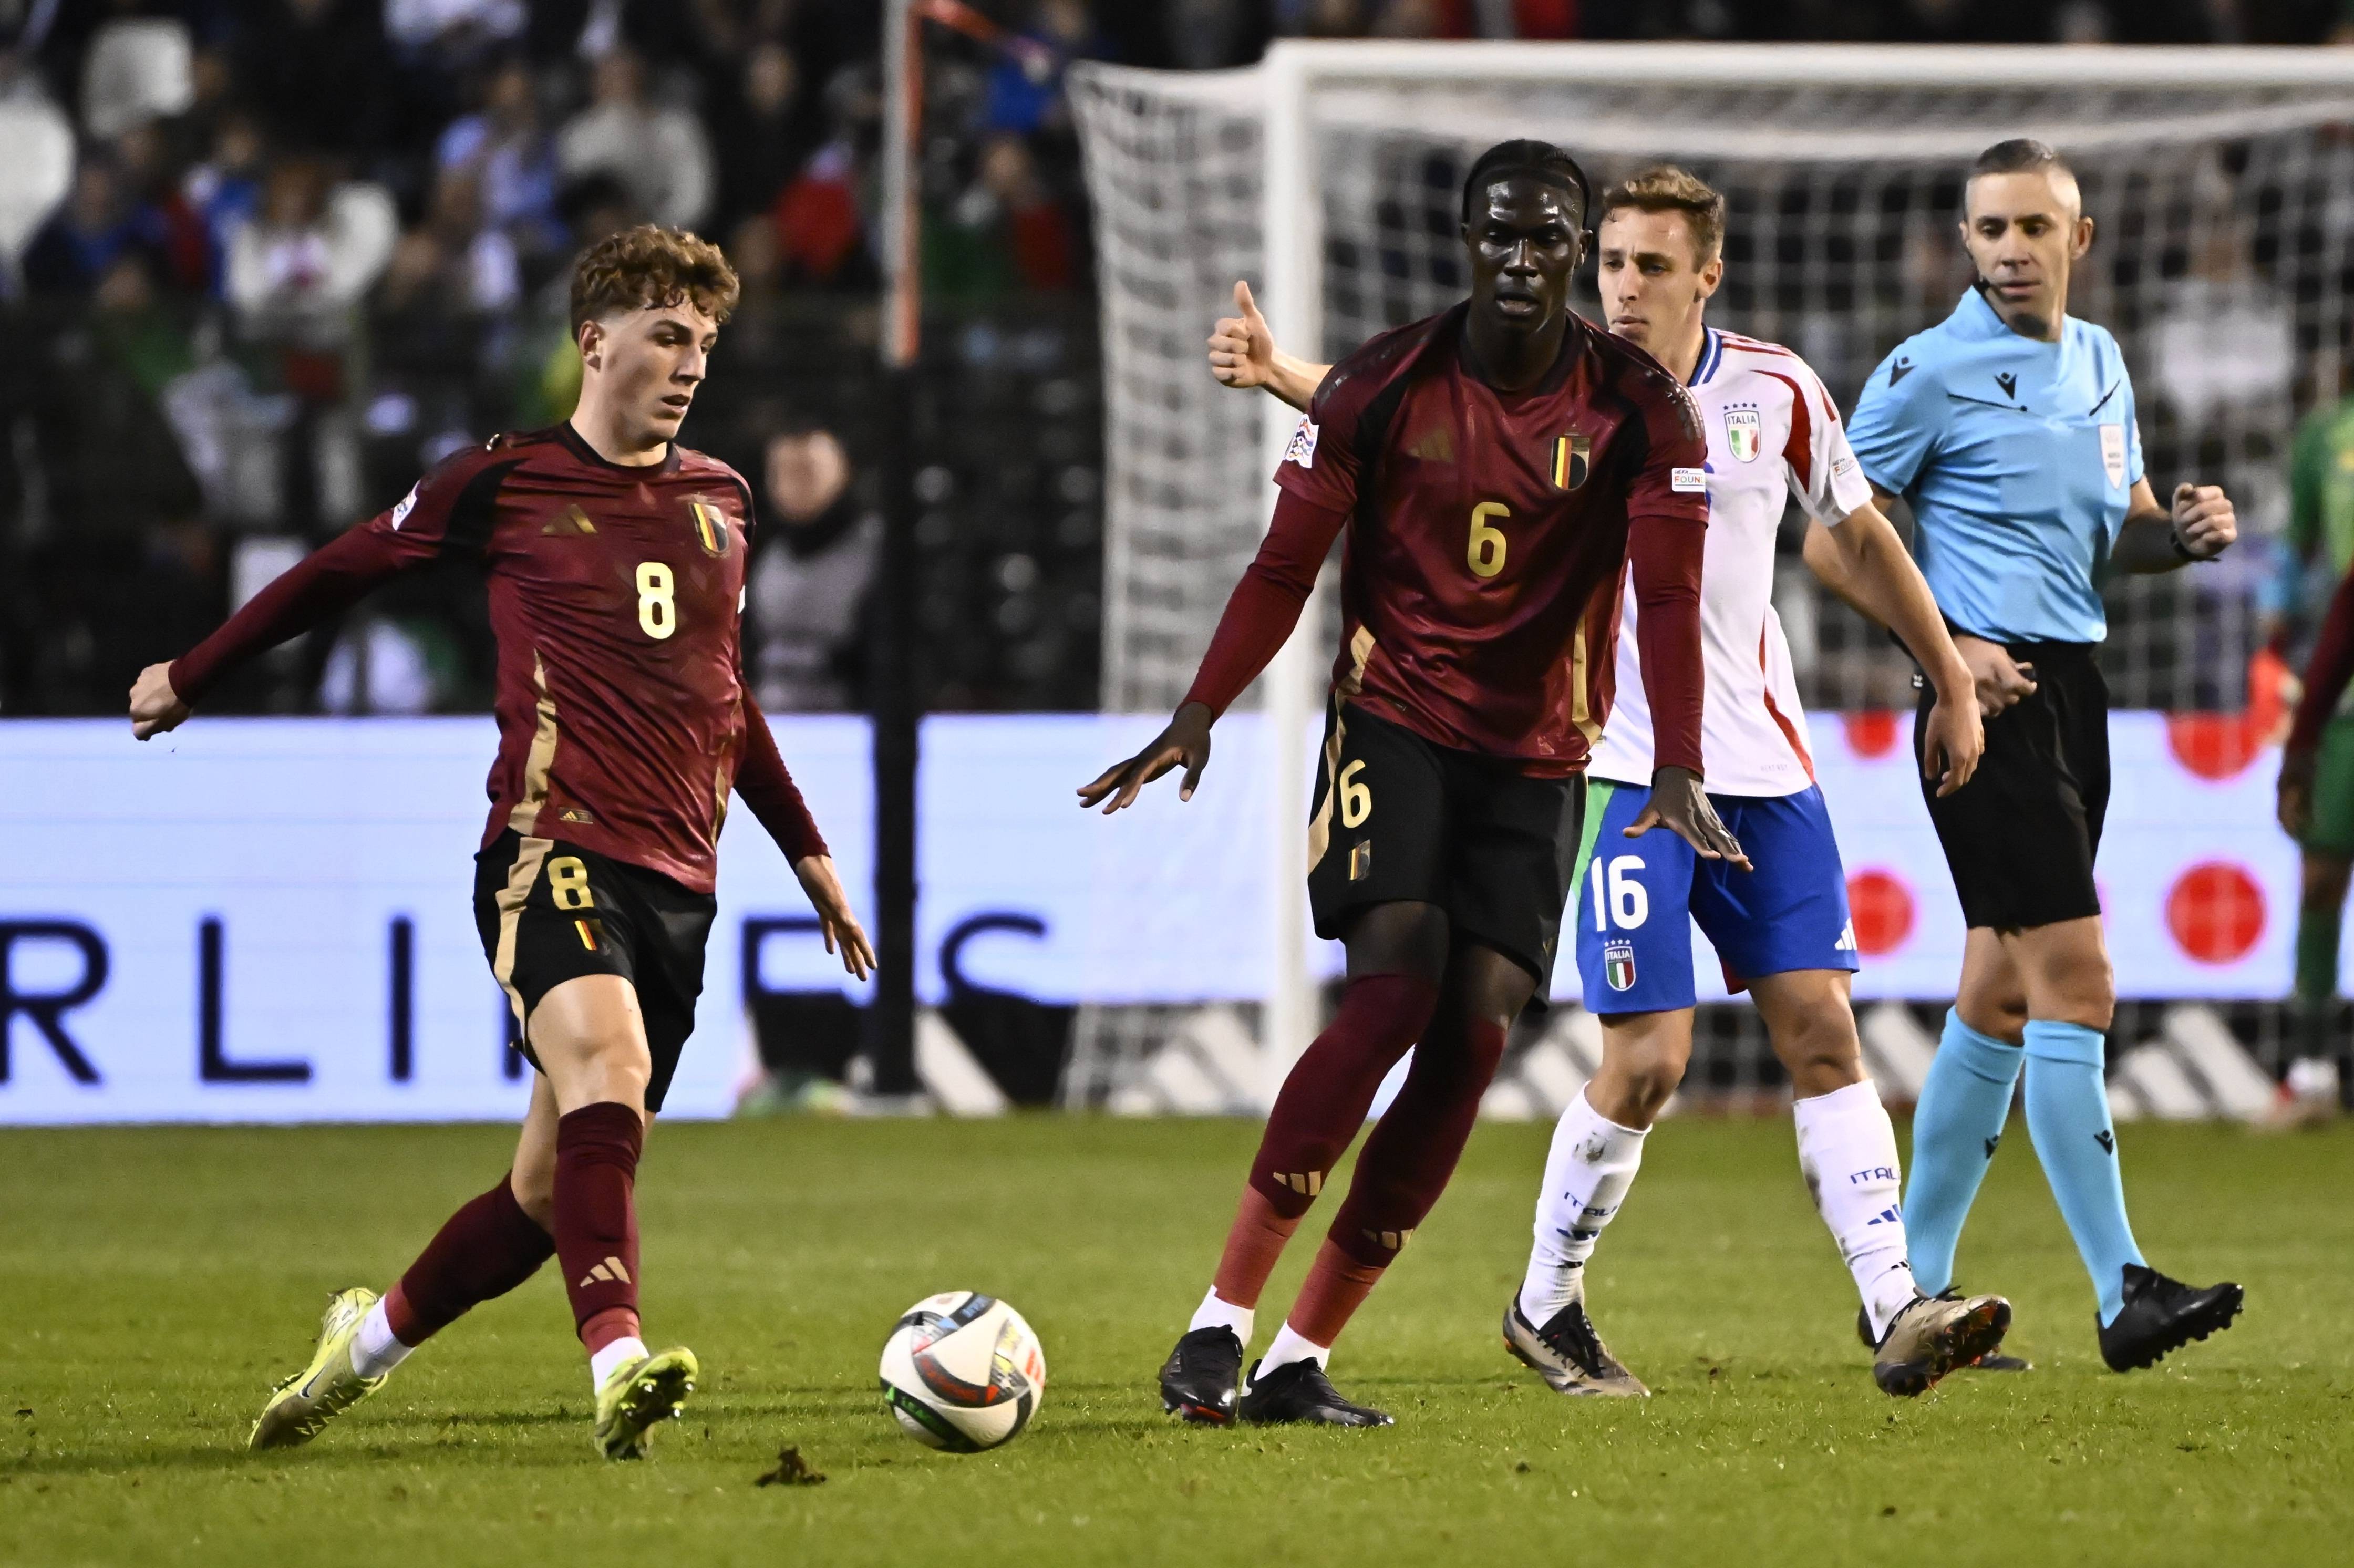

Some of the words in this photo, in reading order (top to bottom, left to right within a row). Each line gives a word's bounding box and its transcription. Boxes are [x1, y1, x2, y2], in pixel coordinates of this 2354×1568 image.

[1727, 415, 1757, 424] ITALIA
[1467, 502, 1510, 577] 6
[636, 562, 676, 639] 8
[1340, 759, 1371, 828] 6
[547, 856, 594, 910] 8
[1591, 855, 1648, 932] 16
[1607, 950, 1630, 960] ITALIA
